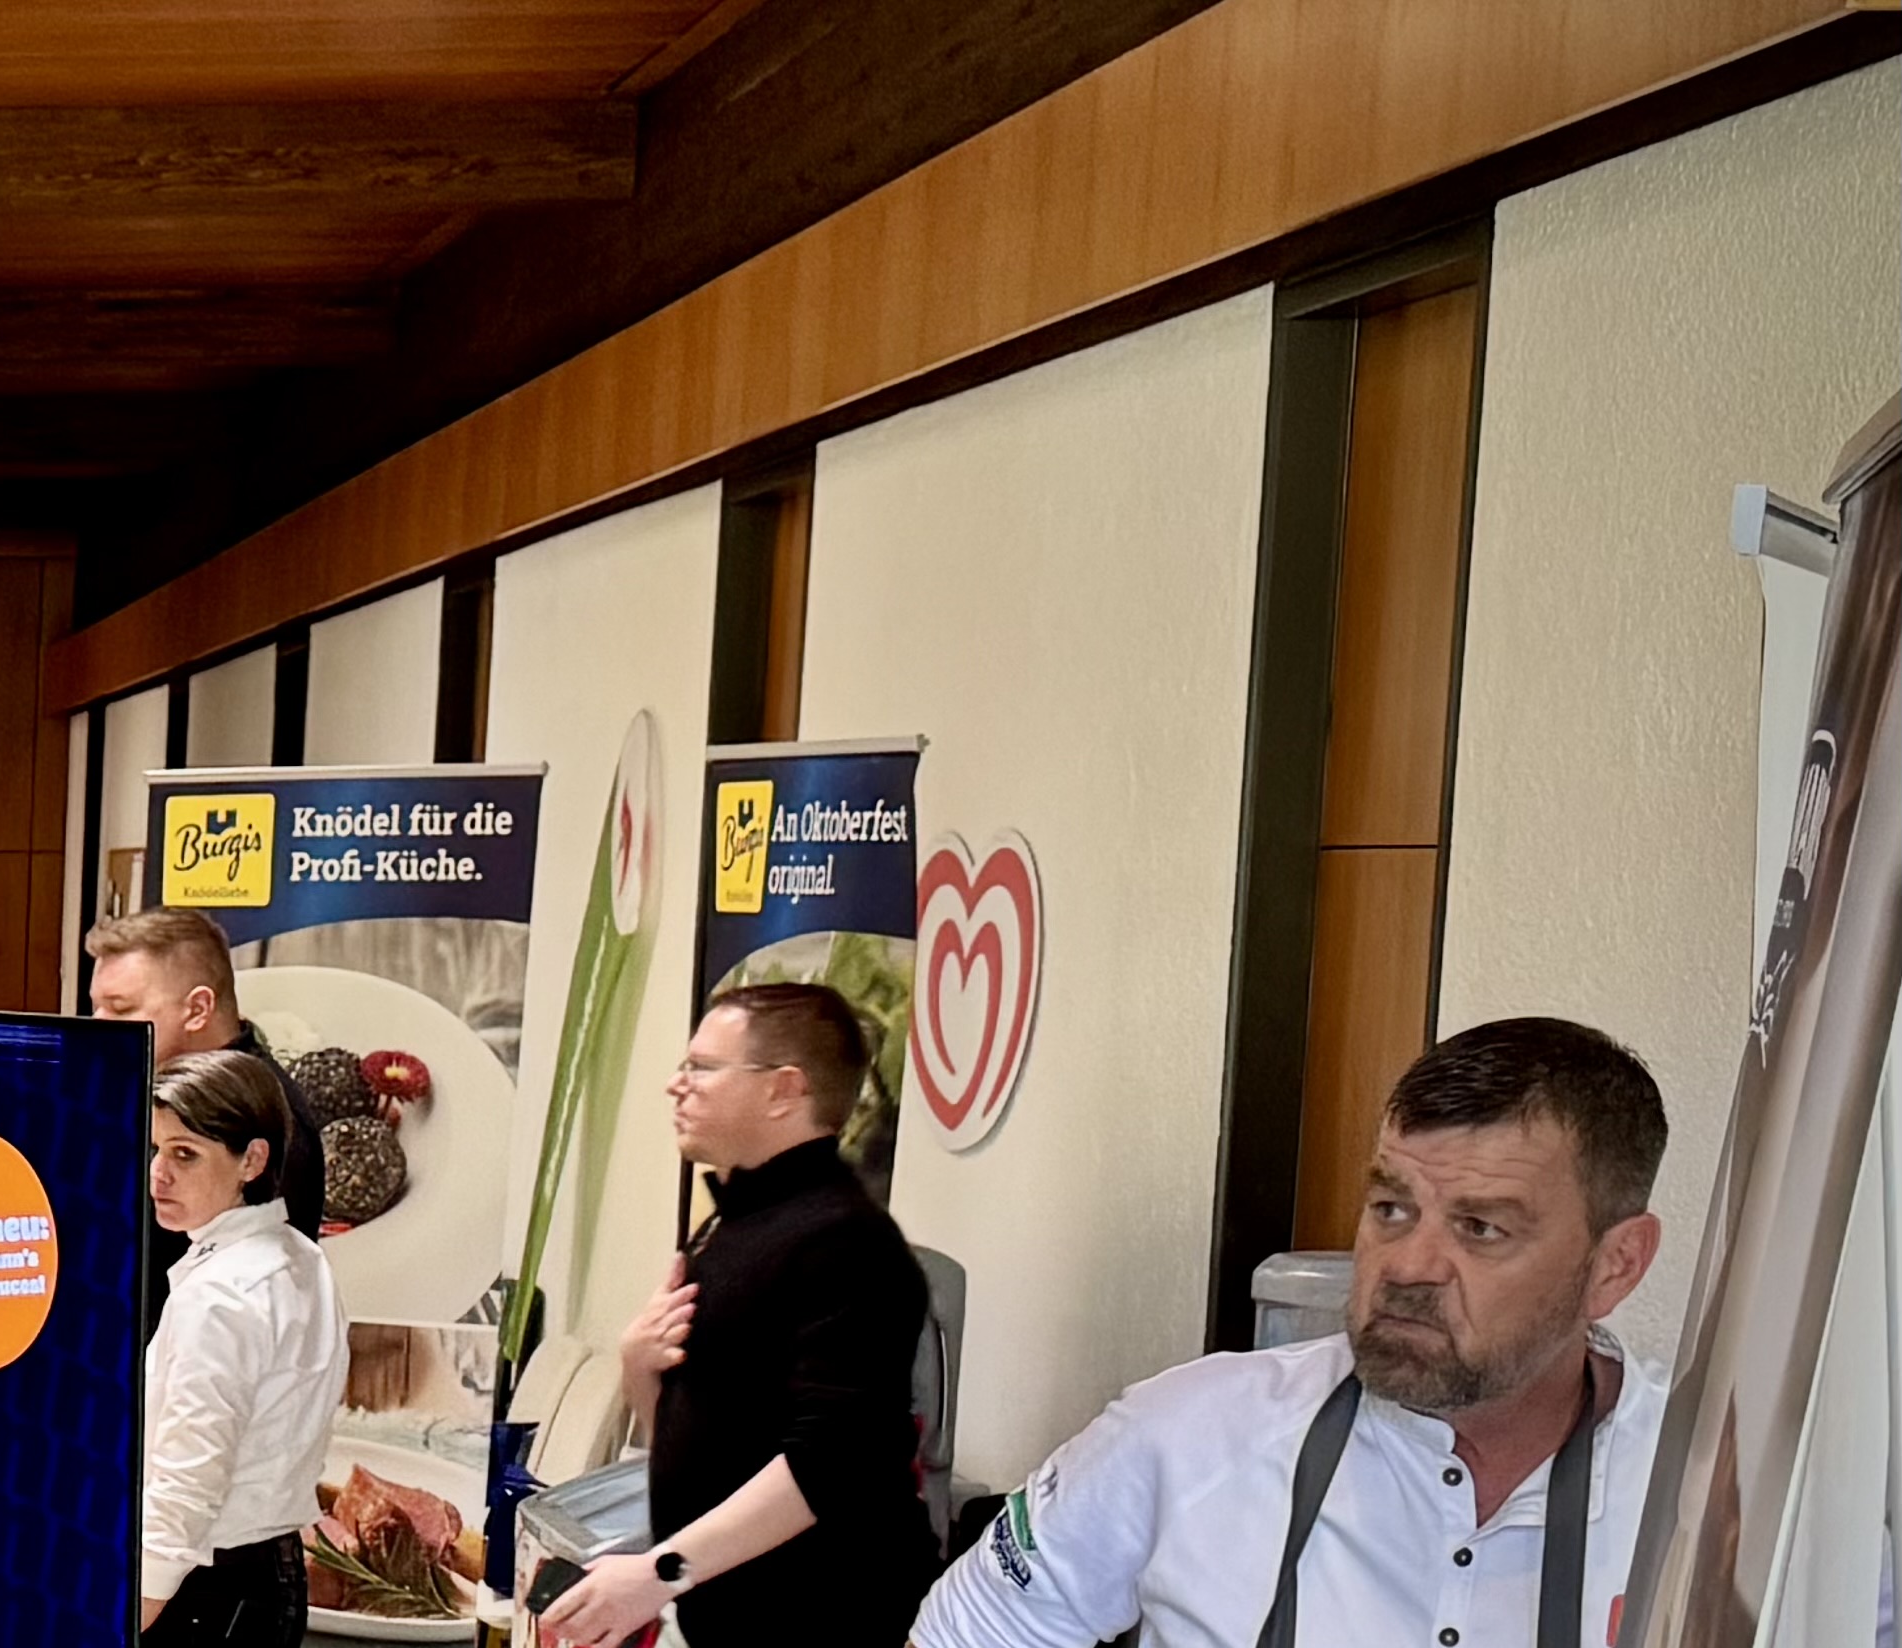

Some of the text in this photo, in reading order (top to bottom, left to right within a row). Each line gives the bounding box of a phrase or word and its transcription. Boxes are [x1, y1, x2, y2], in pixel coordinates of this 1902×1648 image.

[292, 802, 514, 837] Knödel für die
[770, 799, 908, 842] An Oktoberfest
[173, 823, 262, 881] Burgis
[289, 848, 483, 882] Profi-Küche.
[768, 854, 835, 905] original.
